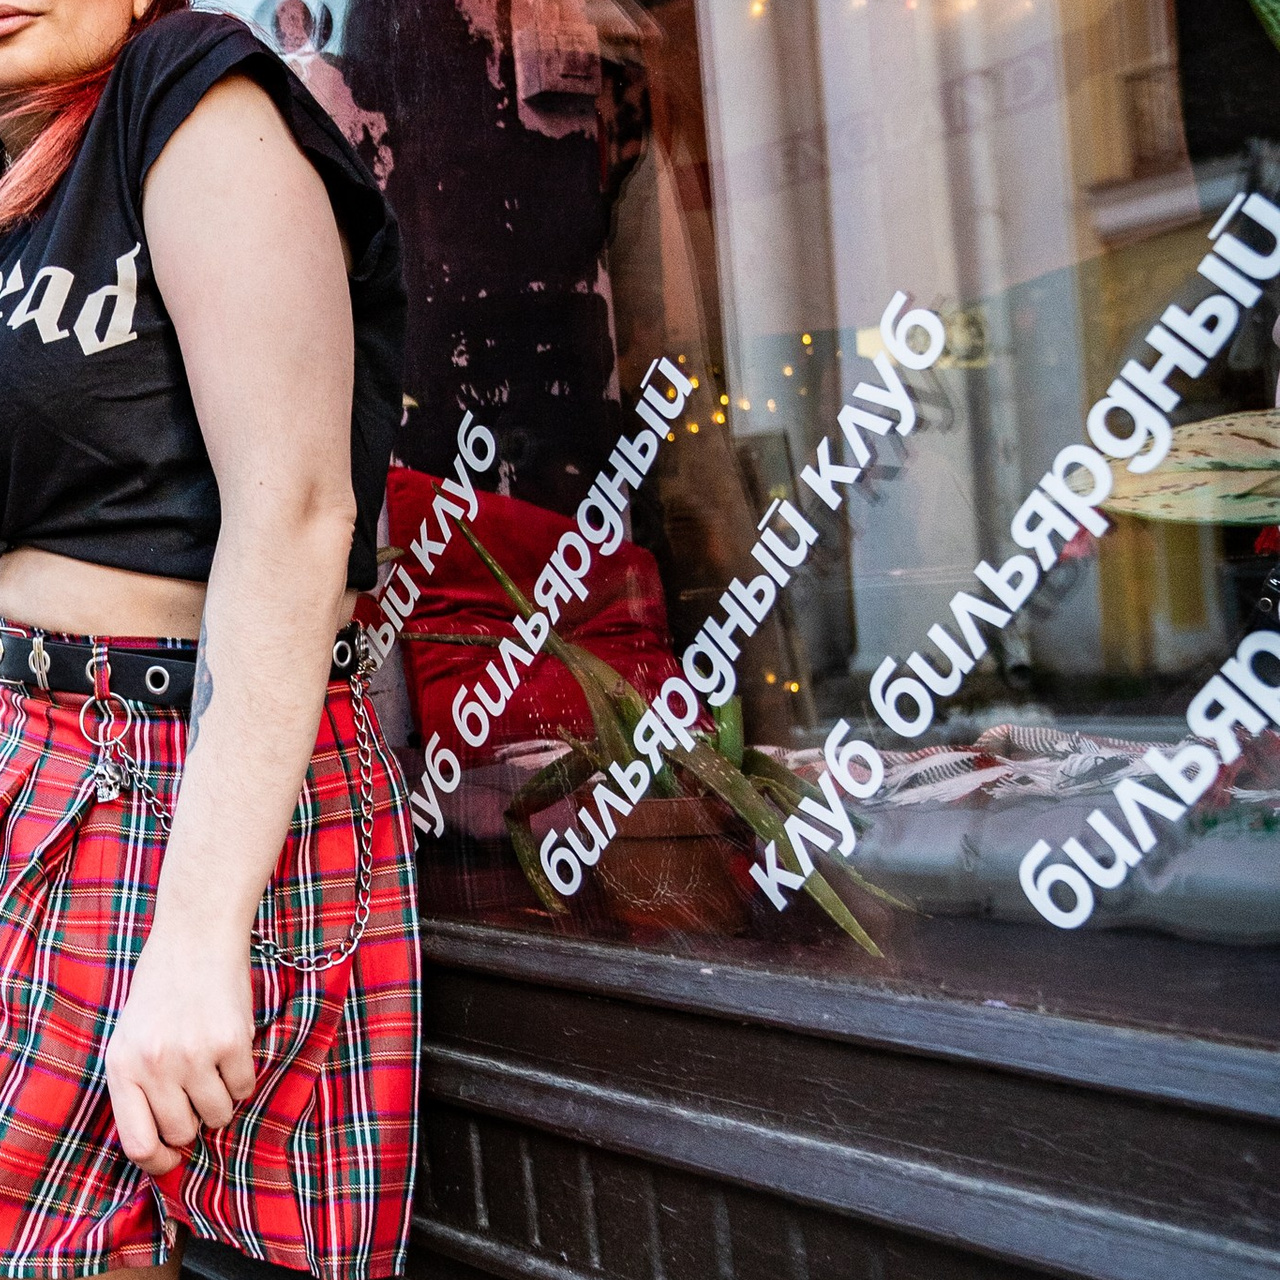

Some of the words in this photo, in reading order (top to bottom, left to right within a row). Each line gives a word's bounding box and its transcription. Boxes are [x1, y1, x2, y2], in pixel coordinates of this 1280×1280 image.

[409, 410, 496, 575] клуб
[453, 356, 695, 748] бильярдный
[538, 497, 819, 898] бильярдный
[800, 290, 945, 510] клуб
[748, 718, 886, 913] клуб
[869, 191, 1280, 738] бильярдный
